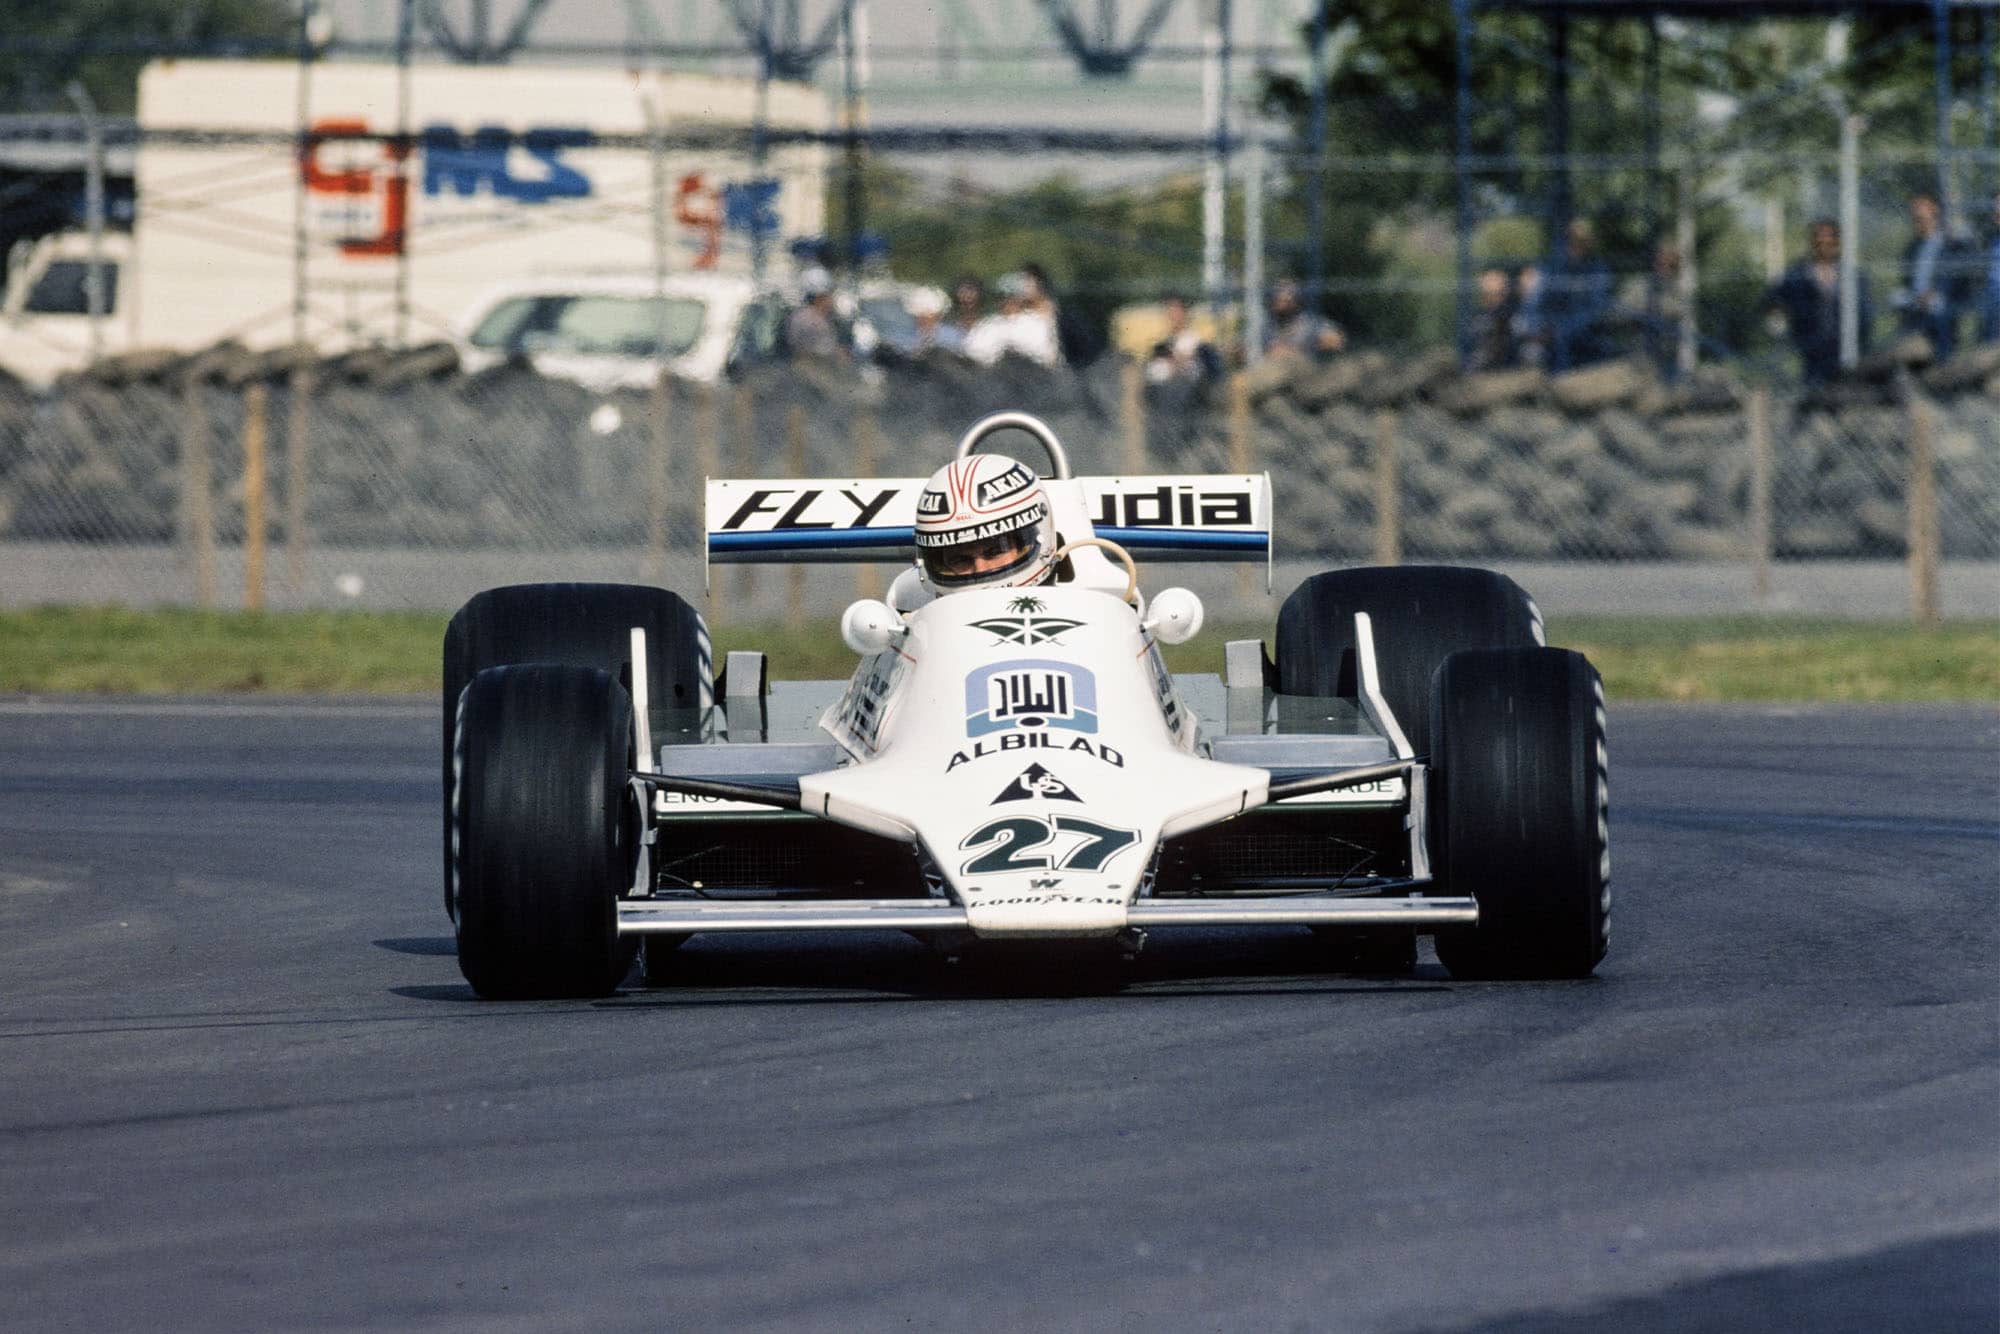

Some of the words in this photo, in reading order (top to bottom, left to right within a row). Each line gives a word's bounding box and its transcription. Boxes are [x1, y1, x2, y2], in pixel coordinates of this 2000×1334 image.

[983, 469, 1027, 500] AKAI
[720, 489, 901, 529] FLY
[928, 532, 956, 547] AKAI
[979, 518, 1015, 539] AKAI
[1015, 507, 1041, 529] AKAI
[946, 732, 1125, 774] ALBILAD
[958, 813, 1142, 876] 27
